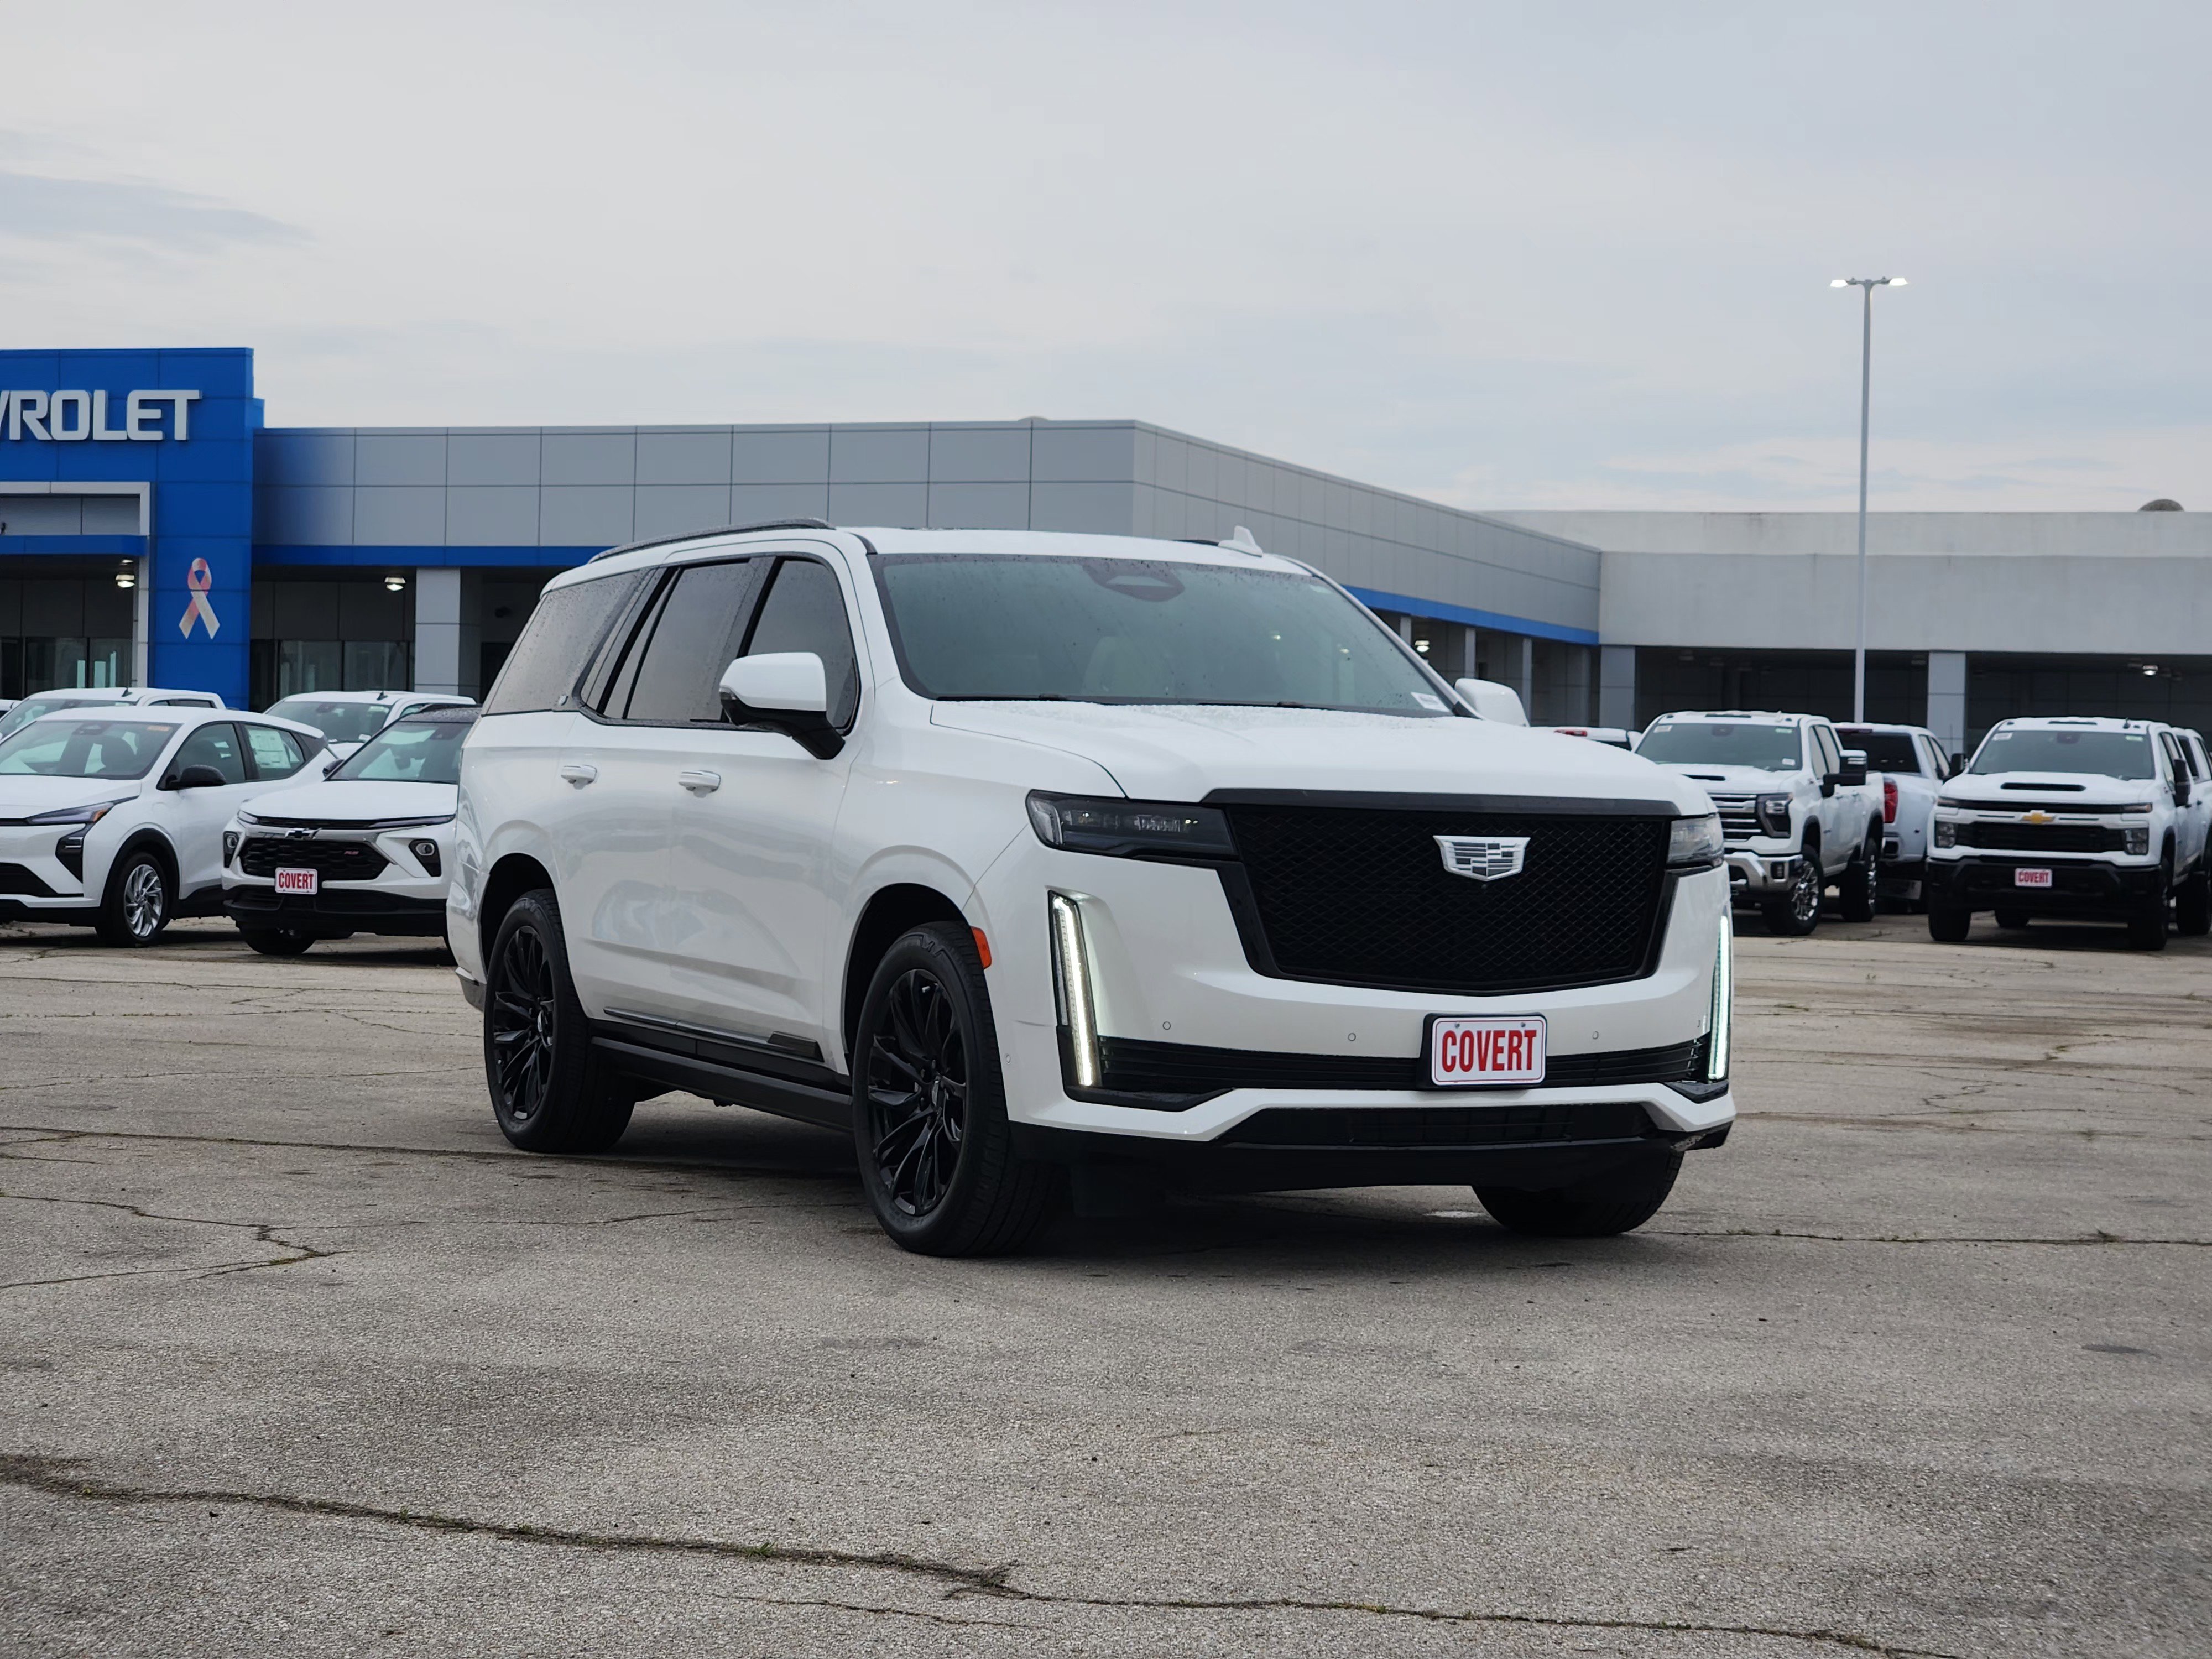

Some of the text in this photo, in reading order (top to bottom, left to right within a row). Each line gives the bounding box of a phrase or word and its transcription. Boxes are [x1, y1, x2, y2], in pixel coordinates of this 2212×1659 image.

[279, 872, 313, 889] COVERT
[2018, 872, 2048, 883] COVERT
[1442, 1030, 1537, 1072] COVERT
